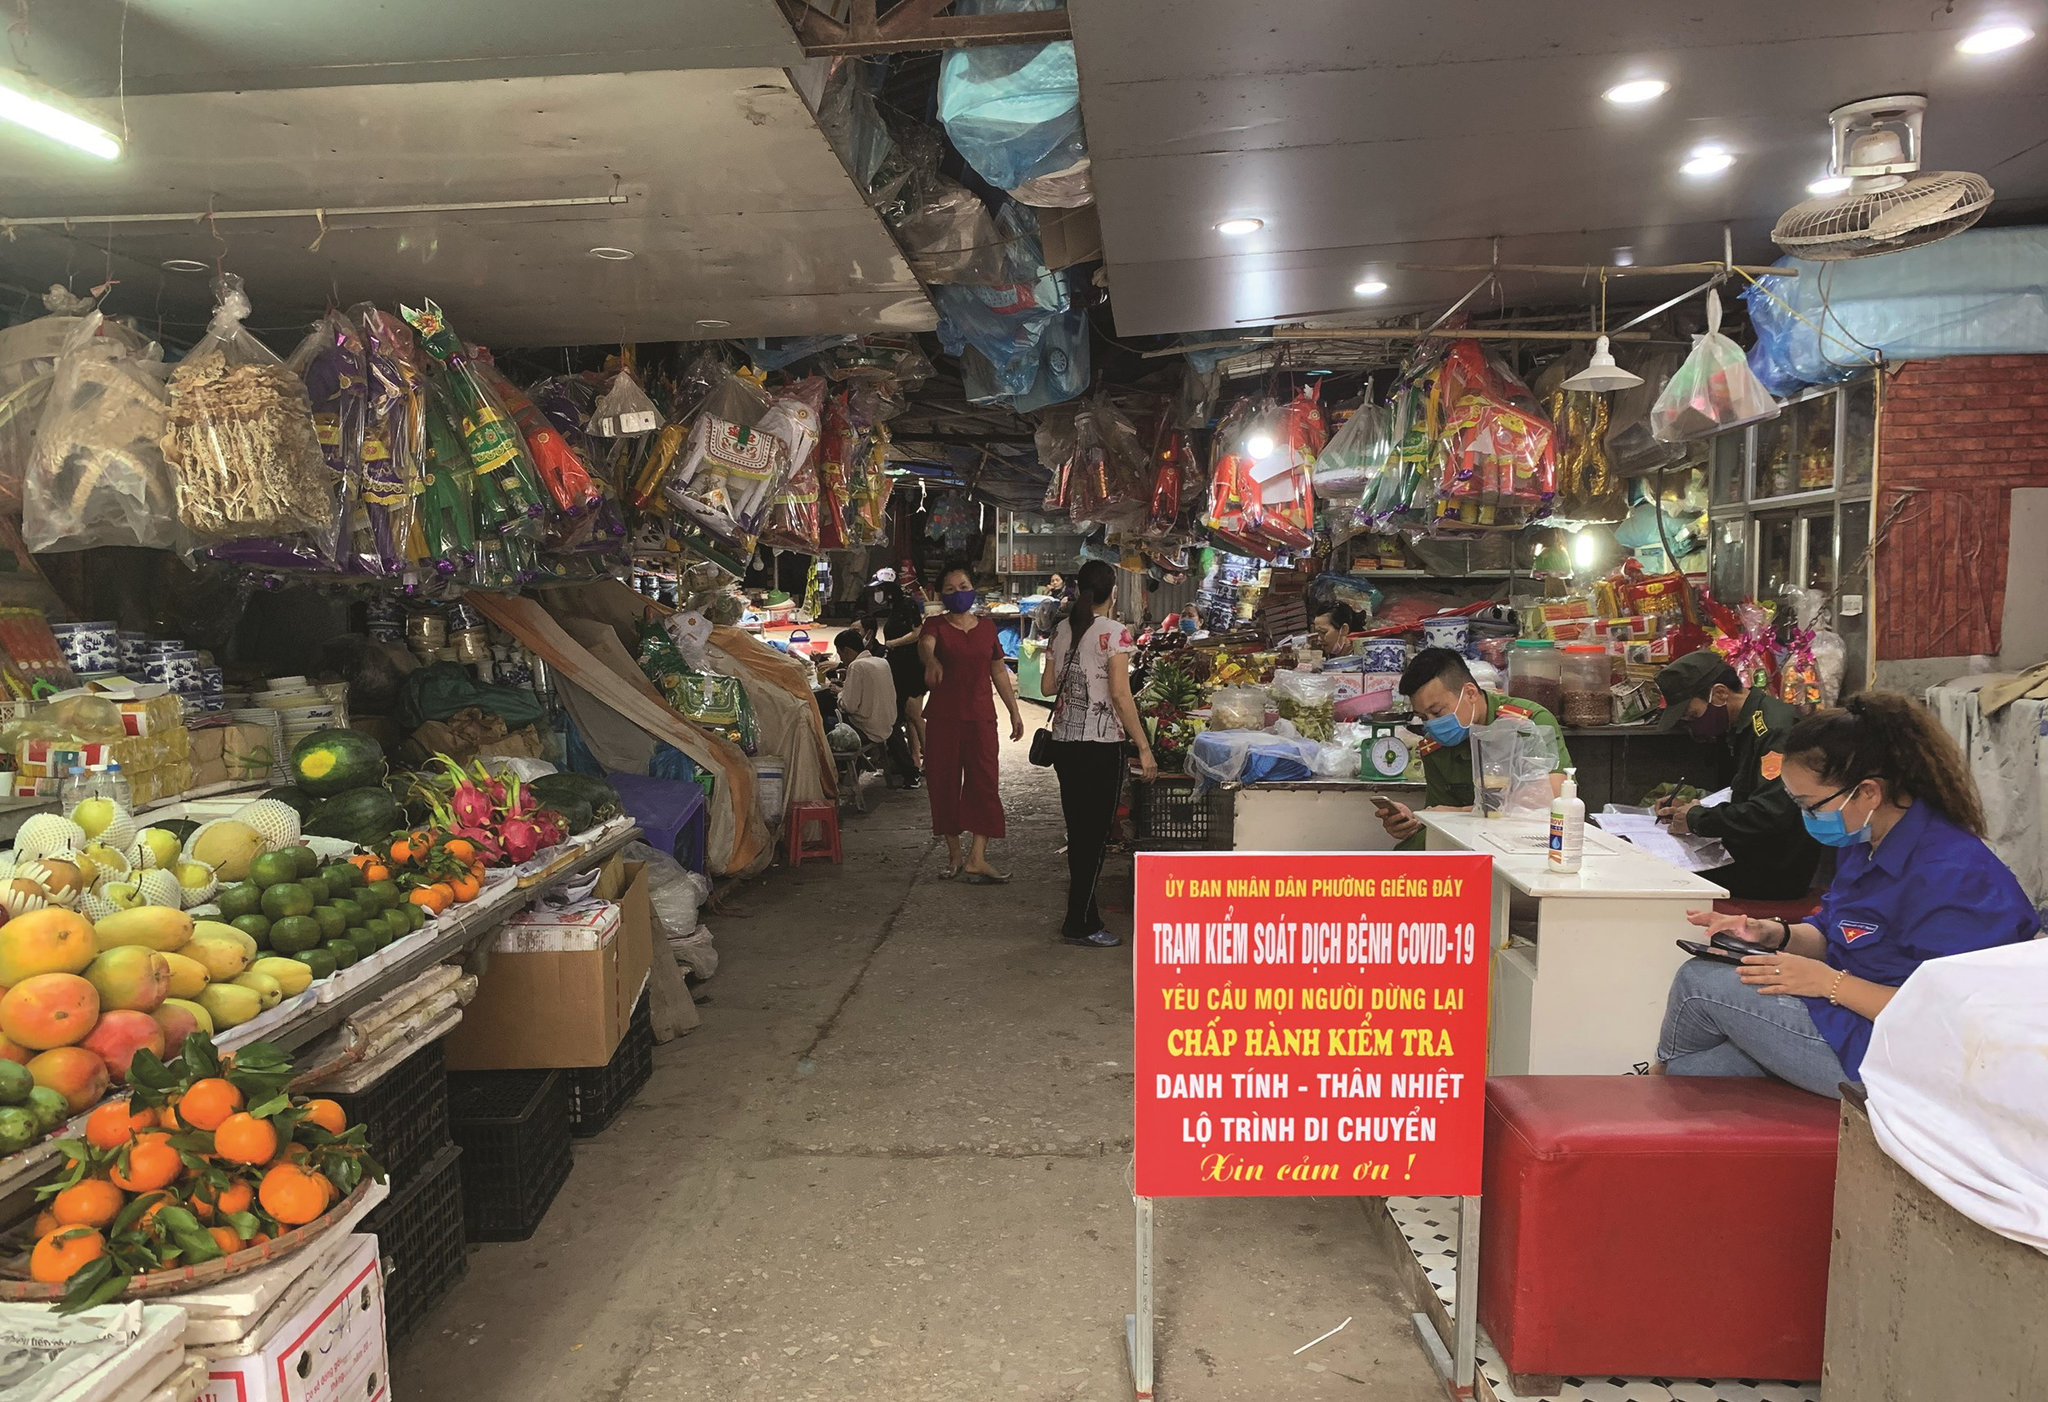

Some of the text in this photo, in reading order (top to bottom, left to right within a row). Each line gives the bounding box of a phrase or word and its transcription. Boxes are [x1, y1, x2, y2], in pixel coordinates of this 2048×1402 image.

[1166, 873, 1463, 897] ỦY BAN NHÂN DÂN PHƯỜNG GIẾNG ĐÁY
[1153, 905, 1474, 974] TRẠM KIỂM SOÁT DỊCH BỆNH COVID-19
[1162, 980, 1463, 1015] YÊU CẦU MỌI NGƯỜI DỪNG LẠI
[1167, 1012, 1454, 1057] CHẤP HÀNH KIỂM TRA
[1156, 1074, 1222, 1098] DANH
[1231, 1067, 1288, 1098] TÍNH
[1317, 1067, 1381, 1098] THÂN
[1391, 1067, 1464, 1104] NHIỆT
[1183, 1106, 1436, 1148] LỘ TRÌNH DI CHUYỂN
[1201, 1153, 1416, 1181] Xin cảm ơn !
